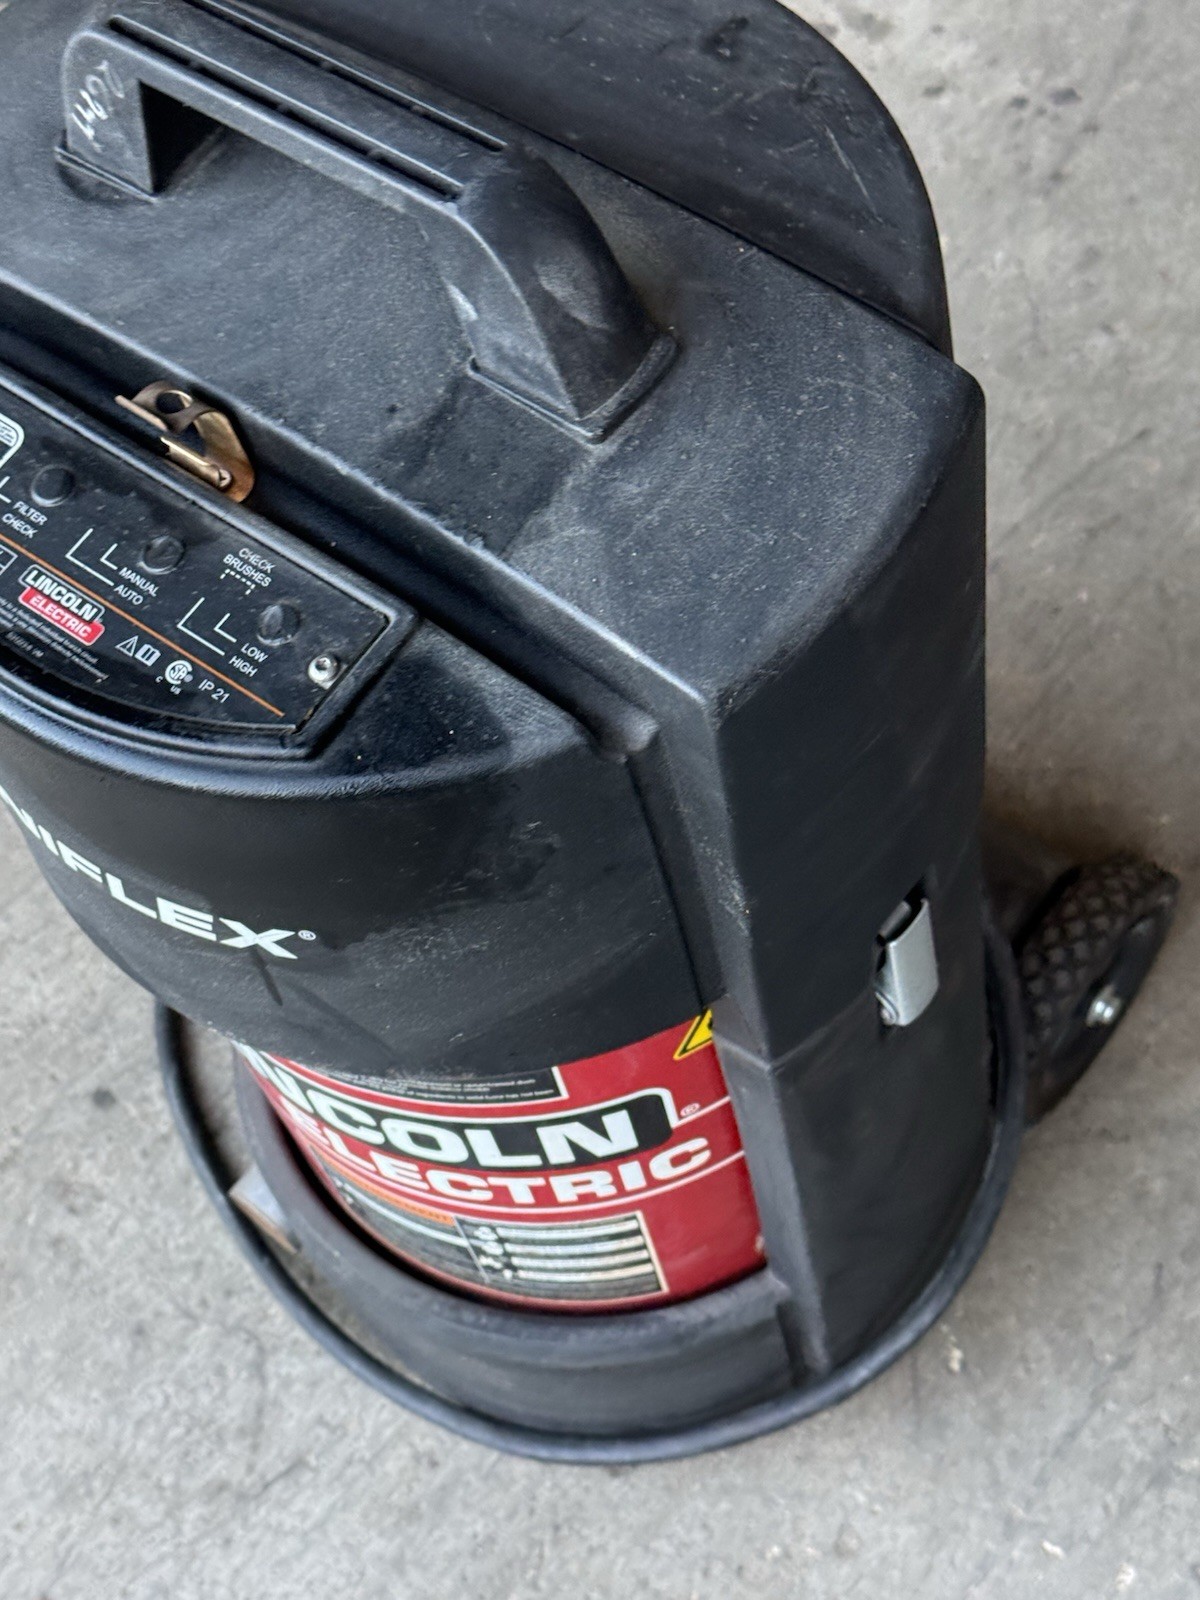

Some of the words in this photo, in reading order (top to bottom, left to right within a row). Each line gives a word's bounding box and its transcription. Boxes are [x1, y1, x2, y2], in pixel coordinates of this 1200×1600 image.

[2, 513, 38, 538] CHECK
[12, 501, 48, 525] FILTER
[222, 554, 272, 587] BRUSHES
[238, 547, 277, 573] CHECK
[118, 566, 160, 597] MANUAL
[24, 569, 98, 621] LINCOLN
[113, 584, 144, 606] AUTO
[28, 595, 92, 638] ELECTRIC
[240, 643, 268, 663] LOW
[228, 655, 258, 678] HIGH
[198, 678, 216, 693] IP
[215, 687, 231, 703] 21
